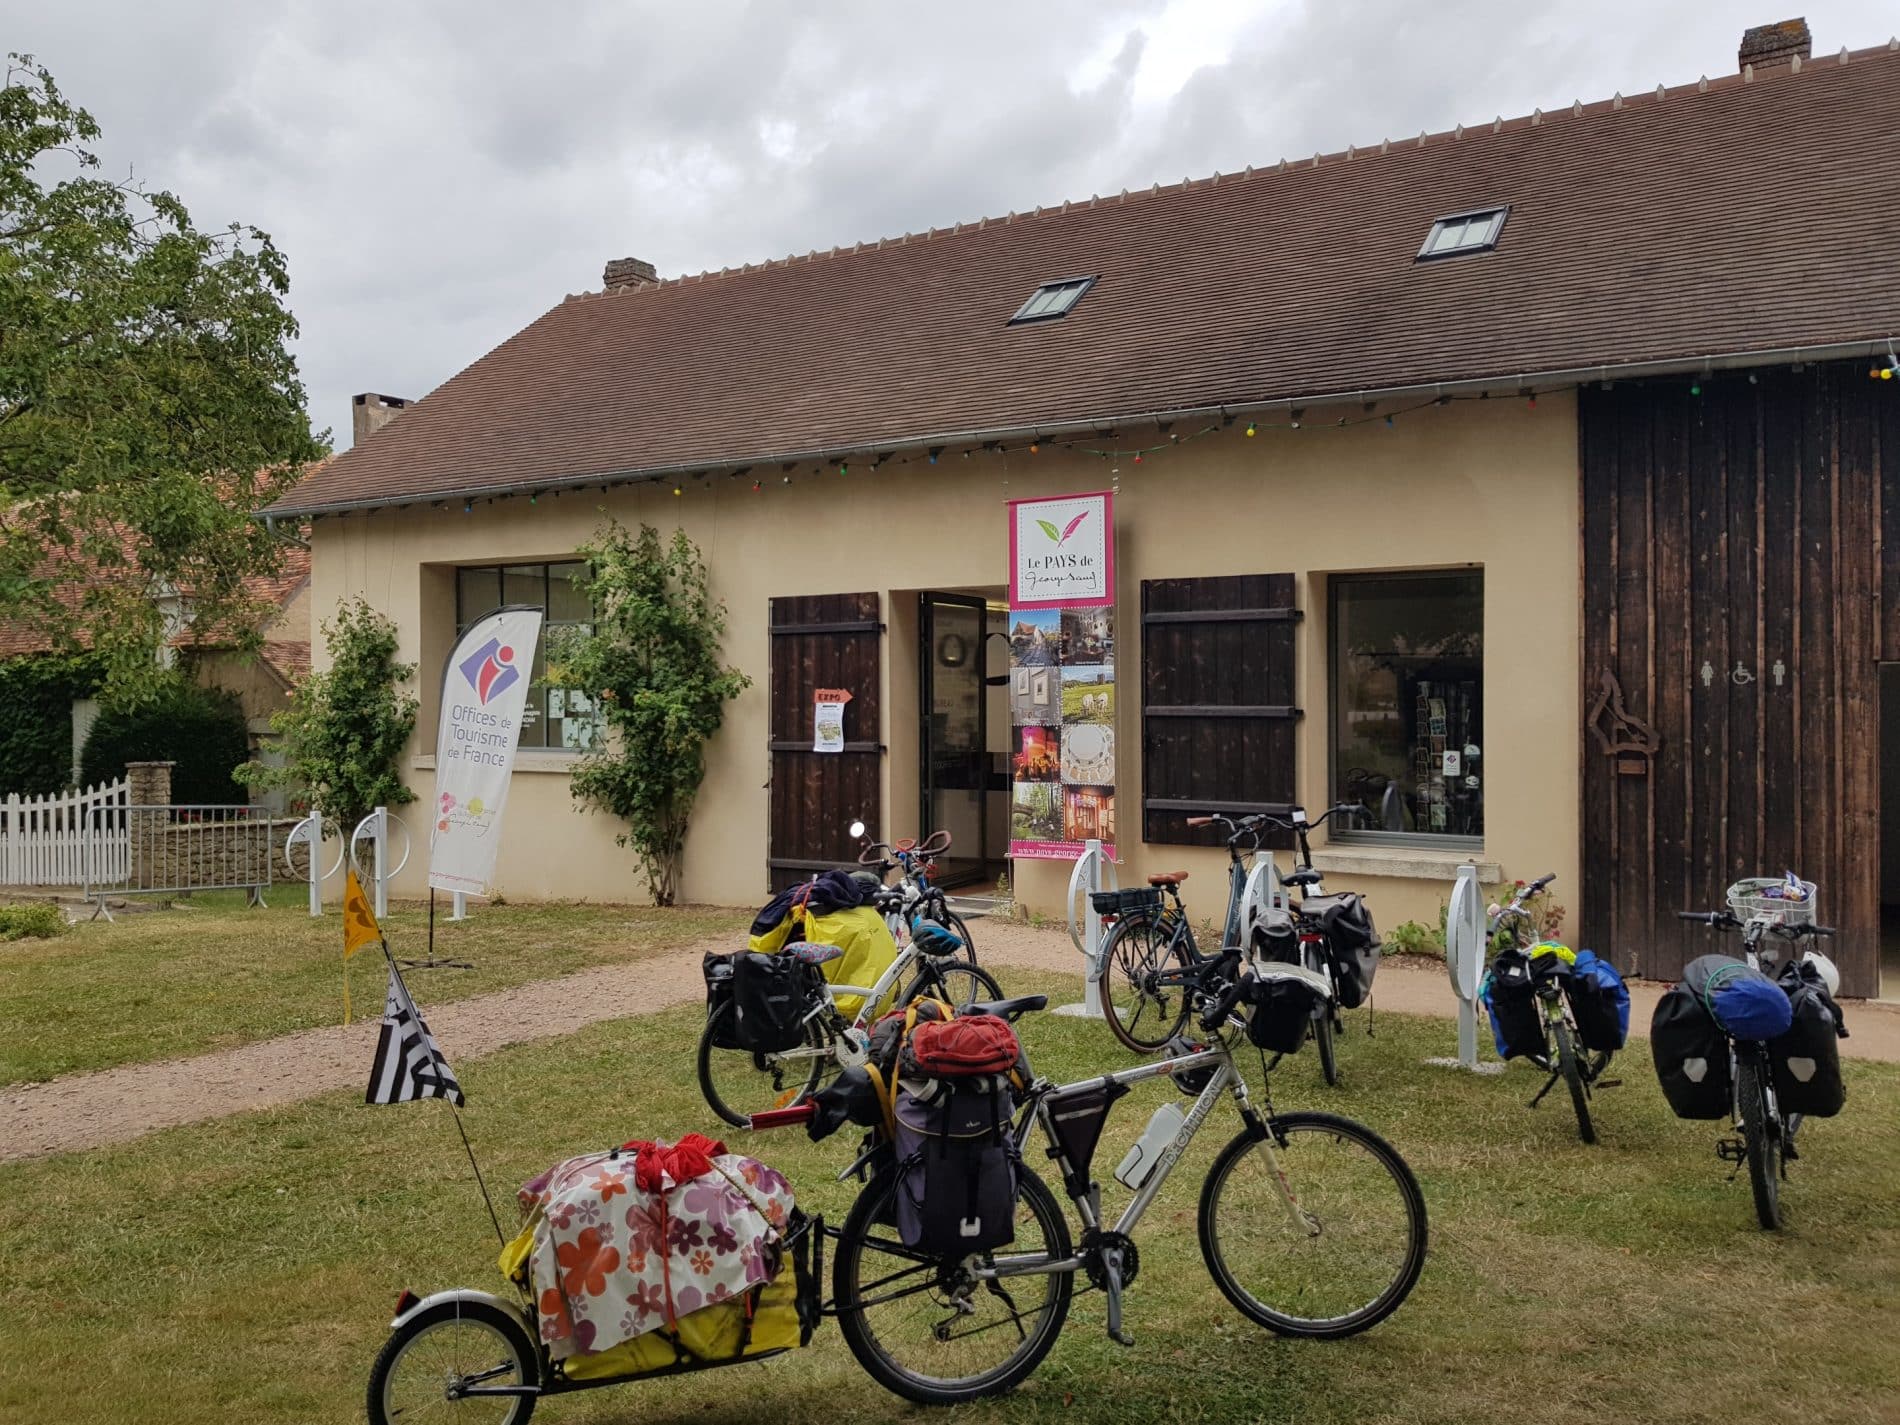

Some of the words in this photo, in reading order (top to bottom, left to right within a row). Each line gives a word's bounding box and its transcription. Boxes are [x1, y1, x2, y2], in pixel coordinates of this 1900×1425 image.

[1028, 558, 1041, 569] Le
[1045, 553, 1077, 569] PAYS
[1080, 555, 1094, 567] de
[818, 693, 841, 701] EXPO
[452, 704, 497, 727] Offices
[501, 715, 512, 729] de
[451, 723, 509, 748] Tourisme
[447, 746, 460, 759] de
[463, 745, 505, 767] France
[1161, 1082, 1222, 1167] DECATHLON
